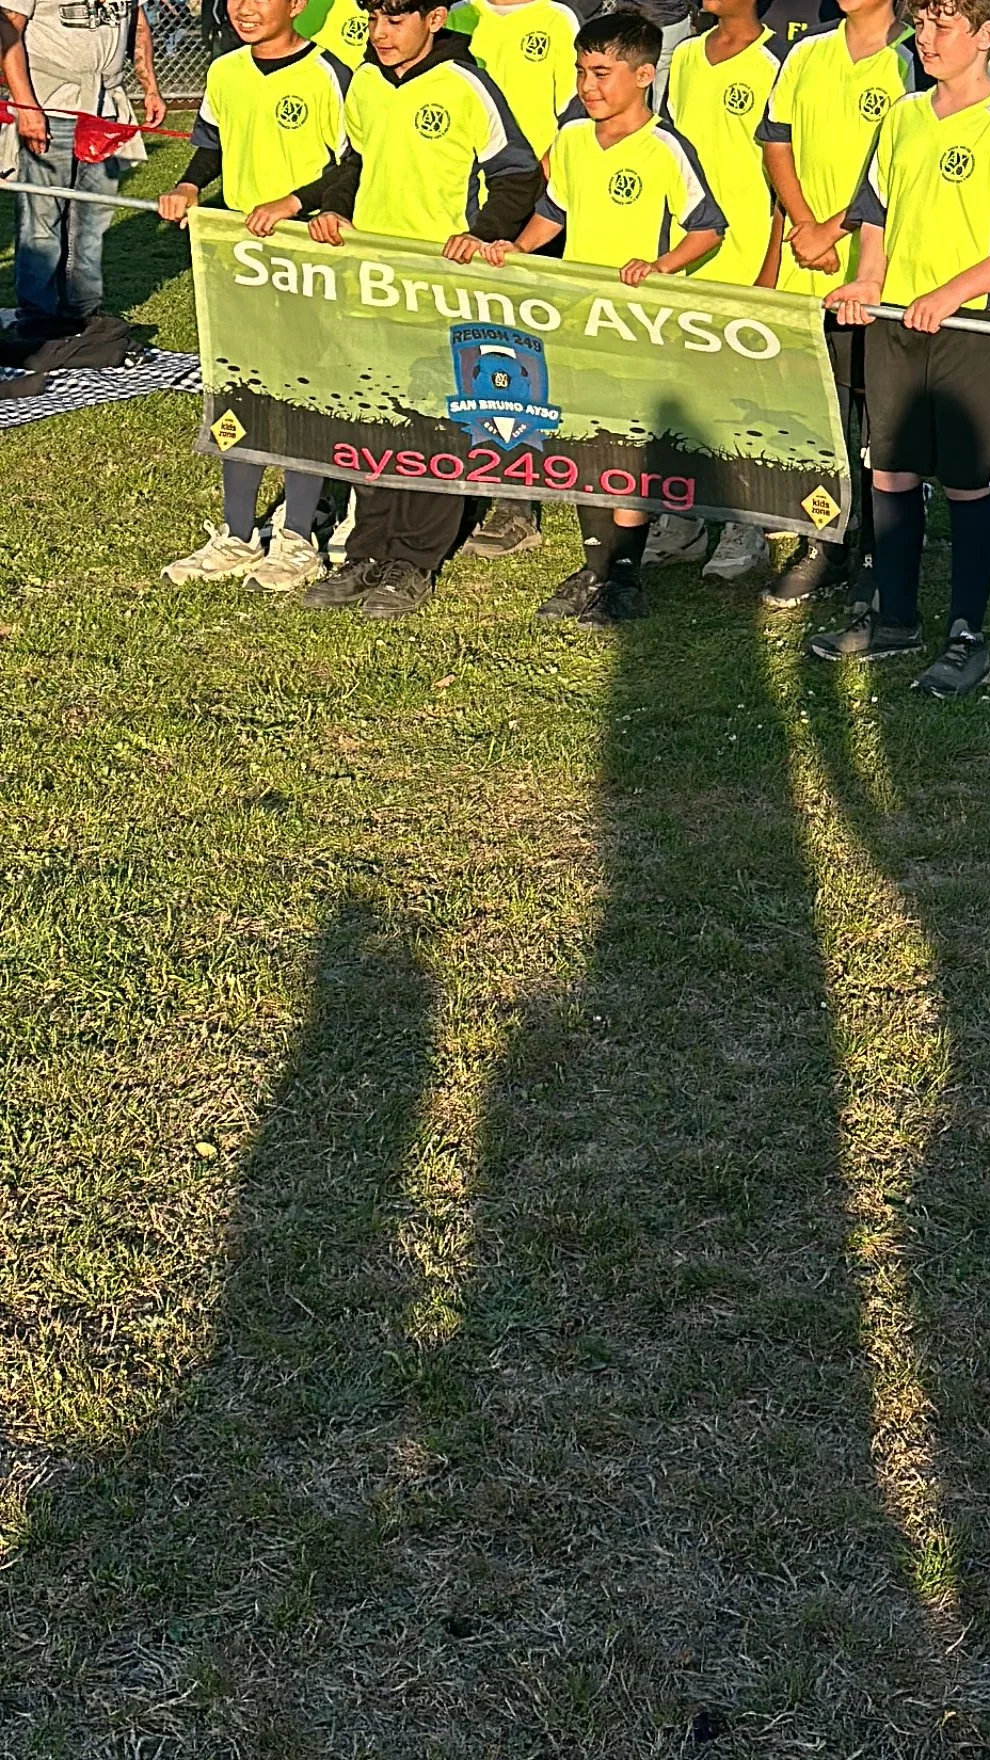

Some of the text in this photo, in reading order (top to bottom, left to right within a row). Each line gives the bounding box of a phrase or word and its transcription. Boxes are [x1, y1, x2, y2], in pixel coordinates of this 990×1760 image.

[233, 240, 781, 360] San Bruno AYSO
[452, 328, 542, 353] REGION 249
[450, 400, 559, 420] SAN BRUNO AYSO
[221, 422, 236, 431] kids
[333, 443, 695, 511] ayso249.org
[812, 499, 830, 509] kids
[812, 507, 831, 516] zone
